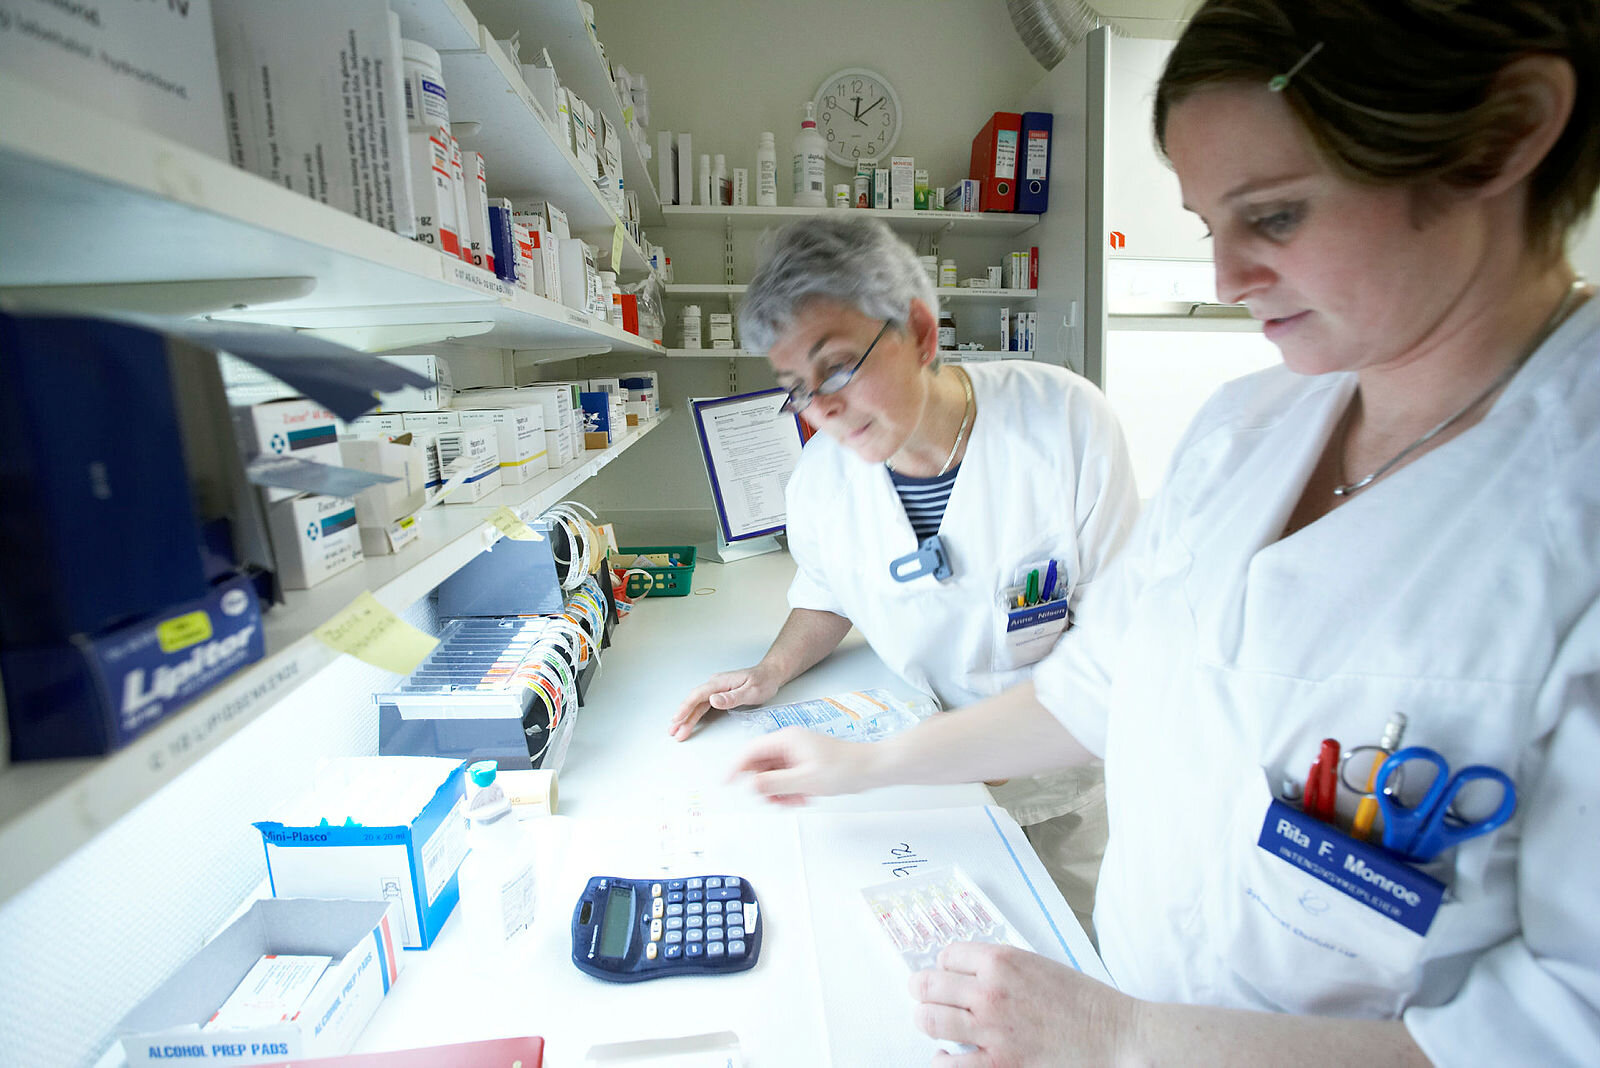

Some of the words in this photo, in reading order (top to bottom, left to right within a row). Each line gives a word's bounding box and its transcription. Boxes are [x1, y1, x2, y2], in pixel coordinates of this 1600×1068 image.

[837, 84, 845, 97] 11
[850, 79, 863, 94] 12
[879, 96, 888, 110] 2
[822, 112, 831, 125] 9
[882, 112, 891, 127] 3
[826, 128, 835, 142] 8
[877, 130, 885, 143] 4
[838, 141, 845, 153] 7
[852, 146, 860, 158] 6
[867, 142, 875, 155] 5
[121, 624, 256, 715] Lipitor
[1276, 818, 1311, 849] Rita
[1317, 840, 1335, 863] F.
[1344, 854, 1422, 908] Monroe
[148, 1045, 208, 1060] ALCOHOL
[212, 1043, 247, 1058] PREP
[251, 1042, 288, 1056] PADS
